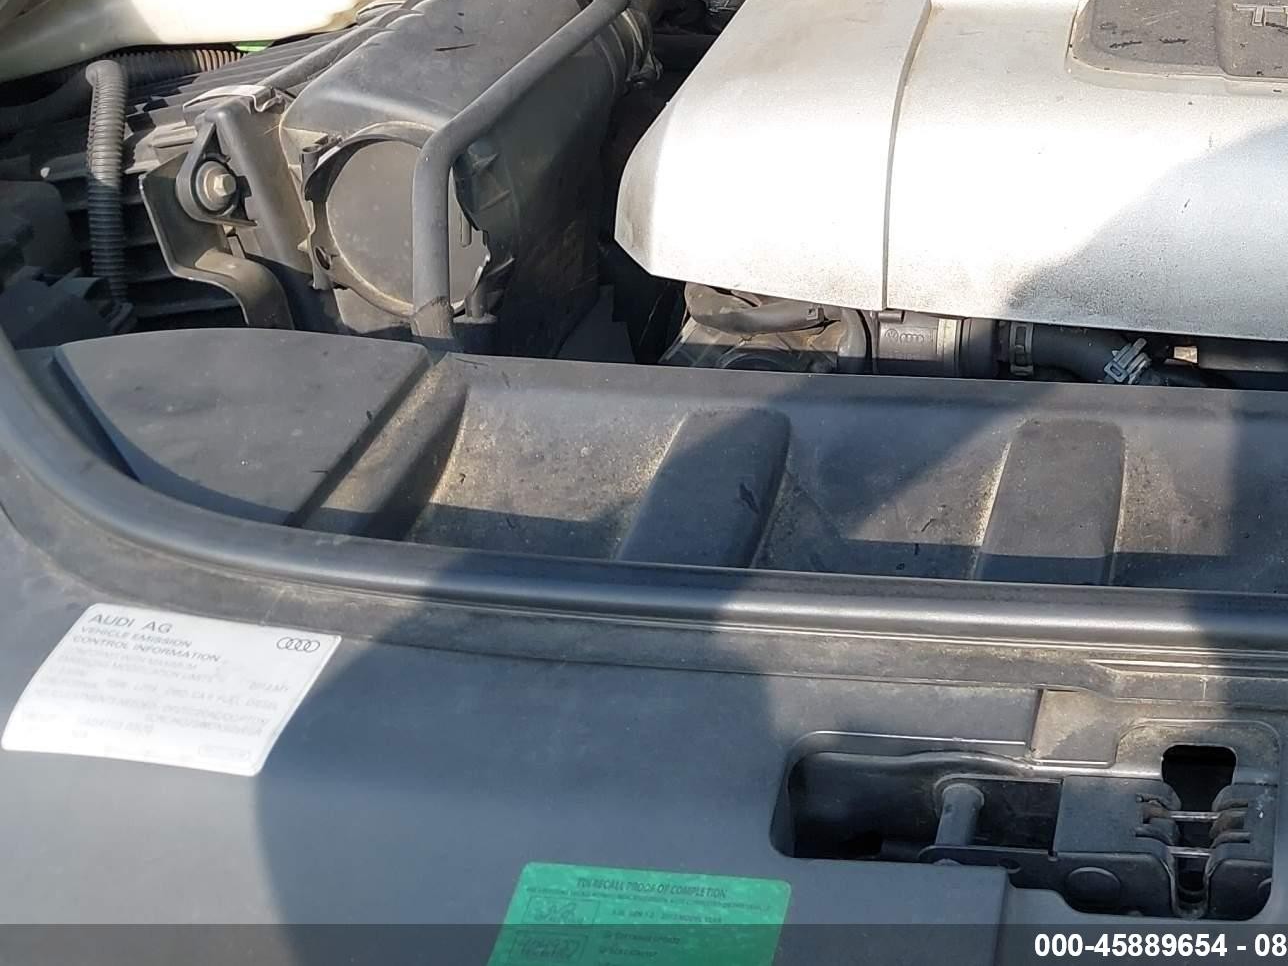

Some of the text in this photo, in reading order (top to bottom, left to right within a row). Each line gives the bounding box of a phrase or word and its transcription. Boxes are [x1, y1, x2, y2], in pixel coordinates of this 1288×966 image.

[88, 614, 173, 634] AUDI AG
[80, 626, 192, 649] VEHICLE EMISSION
[72, 635, 220, 663] CONTROL INFORMATION
[670, 884, 728, 899] COMPLETION
